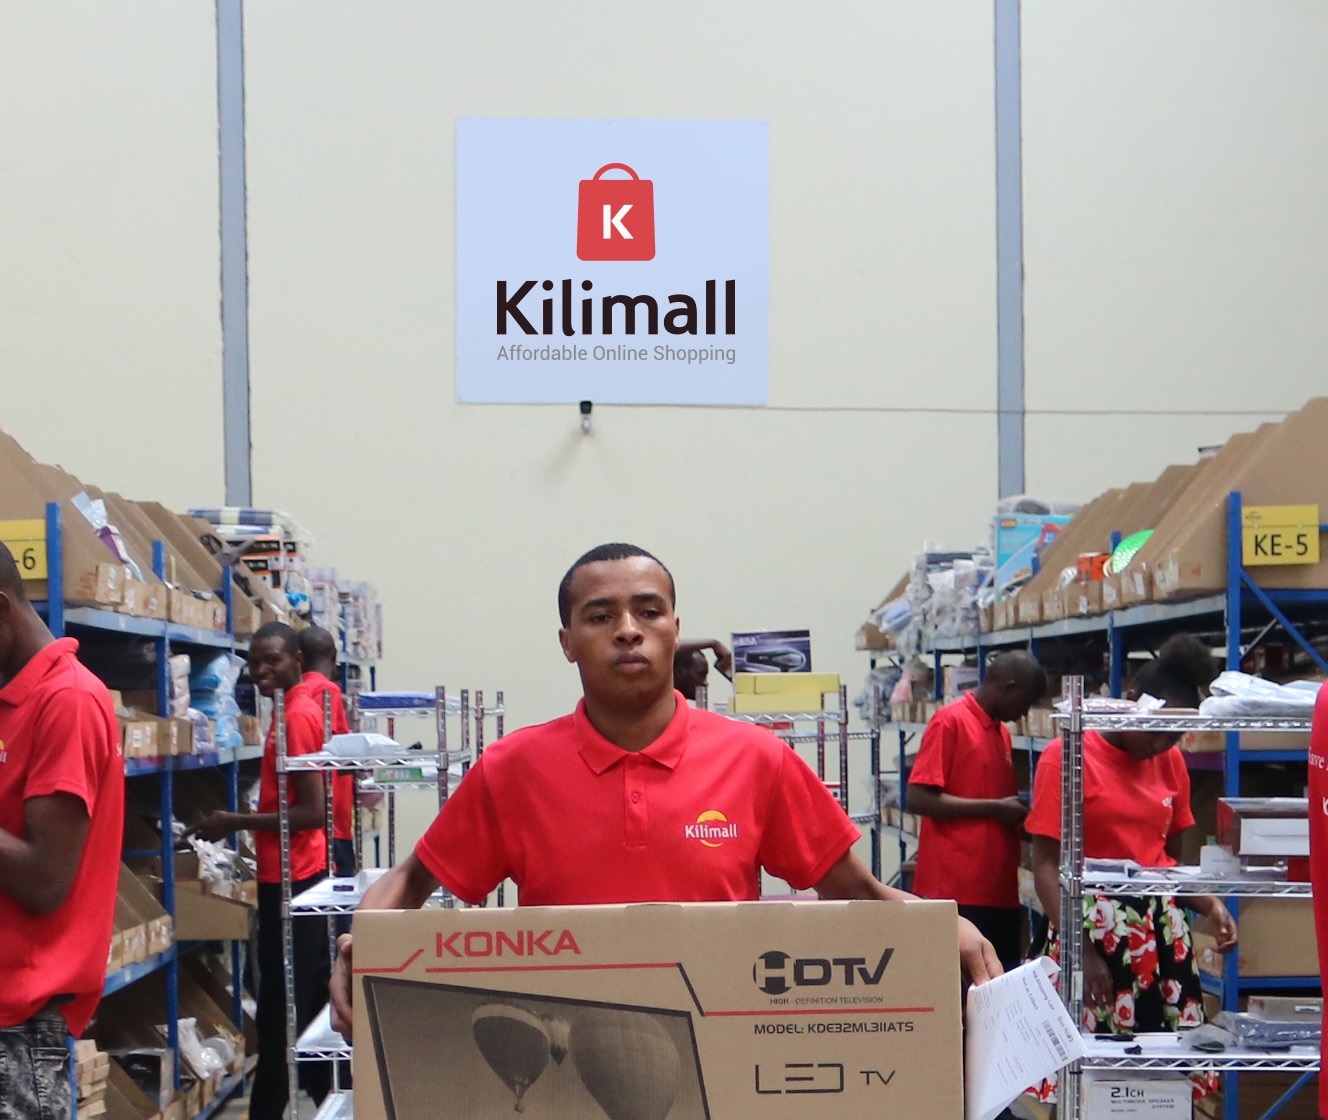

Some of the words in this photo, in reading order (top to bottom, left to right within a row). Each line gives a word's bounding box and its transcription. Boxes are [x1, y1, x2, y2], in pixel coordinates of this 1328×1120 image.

[603, 204, 634, 239] K
[496, 278, 736, 337] Kilimall
[496, 344, 588, 362] Affordable
[593, 345, 648, 362] Online
[653, 344, 736, 365] Shopping
[1254, 533, 1309, 556] KE-5
[1308, 746, 1325, 770] ave
[684, 823, 738, 839] Kilimall
[435, 929, 582, 958] KONKA
[752, 948, 895, 995] HDTV
[770, 997, 789, 1005] HIGH
[795, 996, 838, 1005] DEFINITION
[839, 996, 883, 1004] TELEVISION
[754, 1023, 805, 1035] MODEL:
[754, 1063, 845, 1095] LED
[859, 1070, 896, 1086] TV
[1110, 1086, 1144, 1098] 2.1CH
